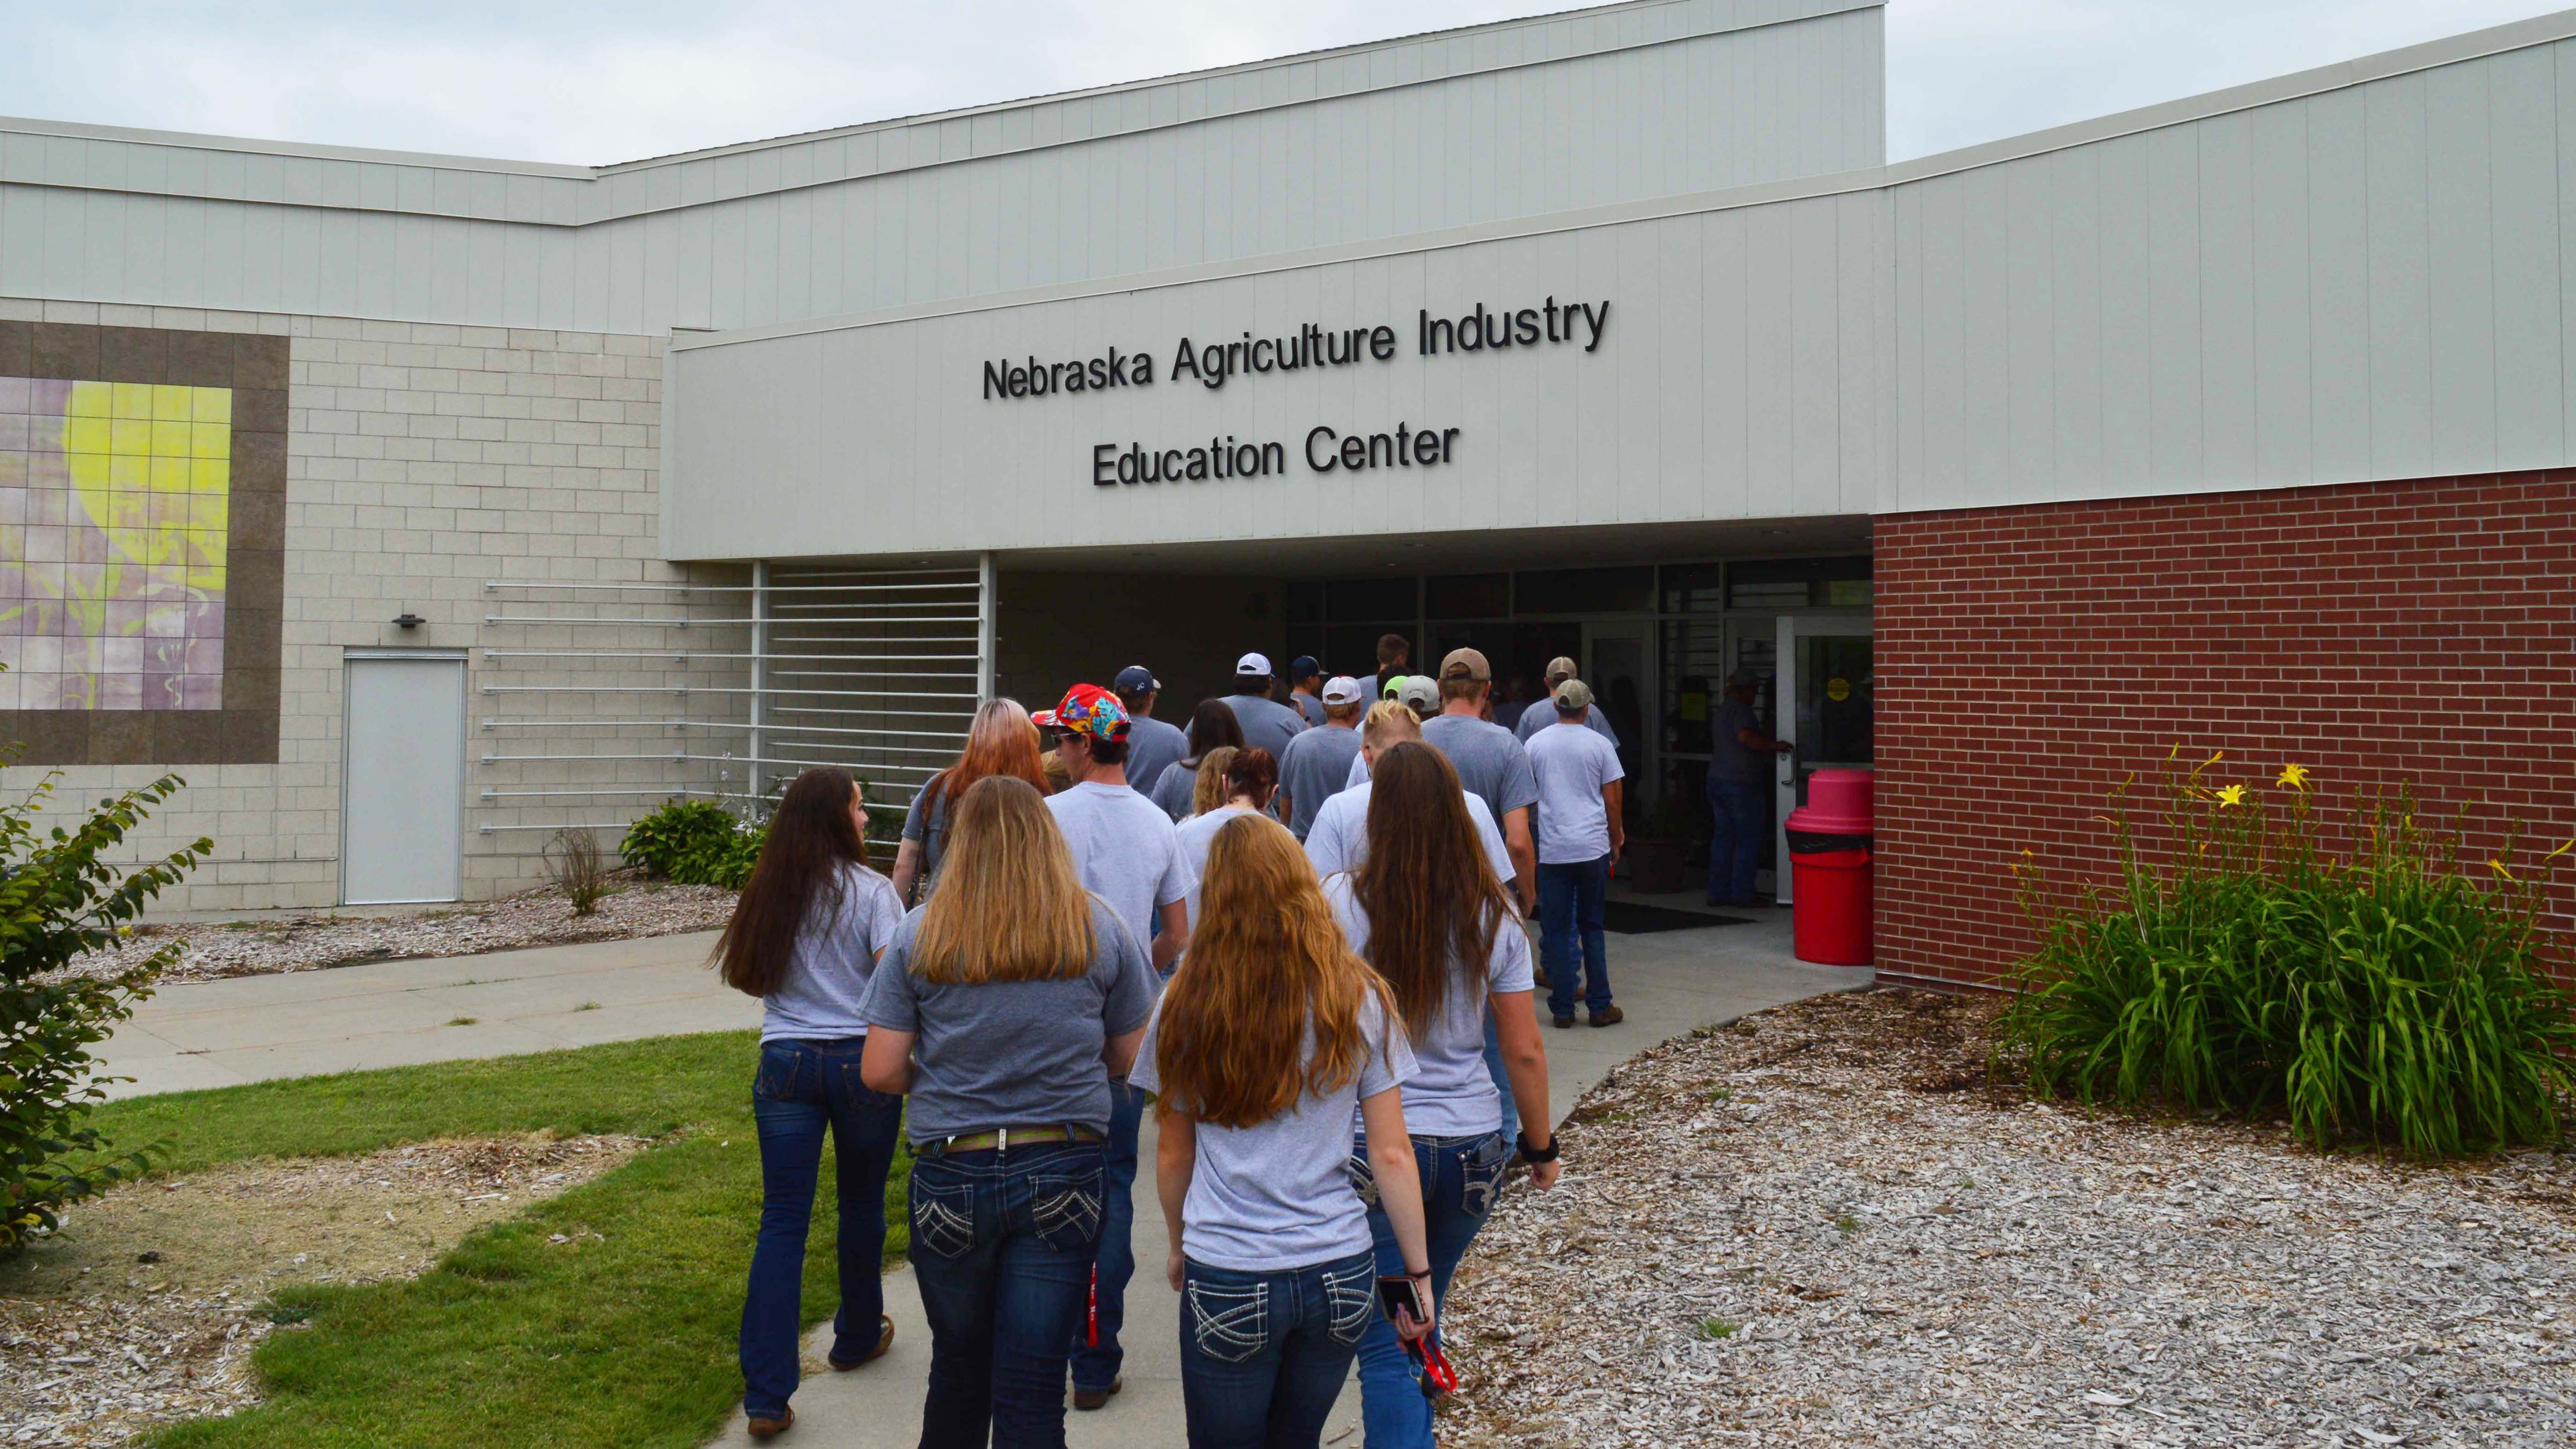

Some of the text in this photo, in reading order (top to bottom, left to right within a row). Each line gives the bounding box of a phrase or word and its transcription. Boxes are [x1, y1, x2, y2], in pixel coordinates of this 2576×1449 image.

[983, 295, 1610, 400] Nebraska Agriculture Industry
[1093, 421, 1460, 488] Education Center
